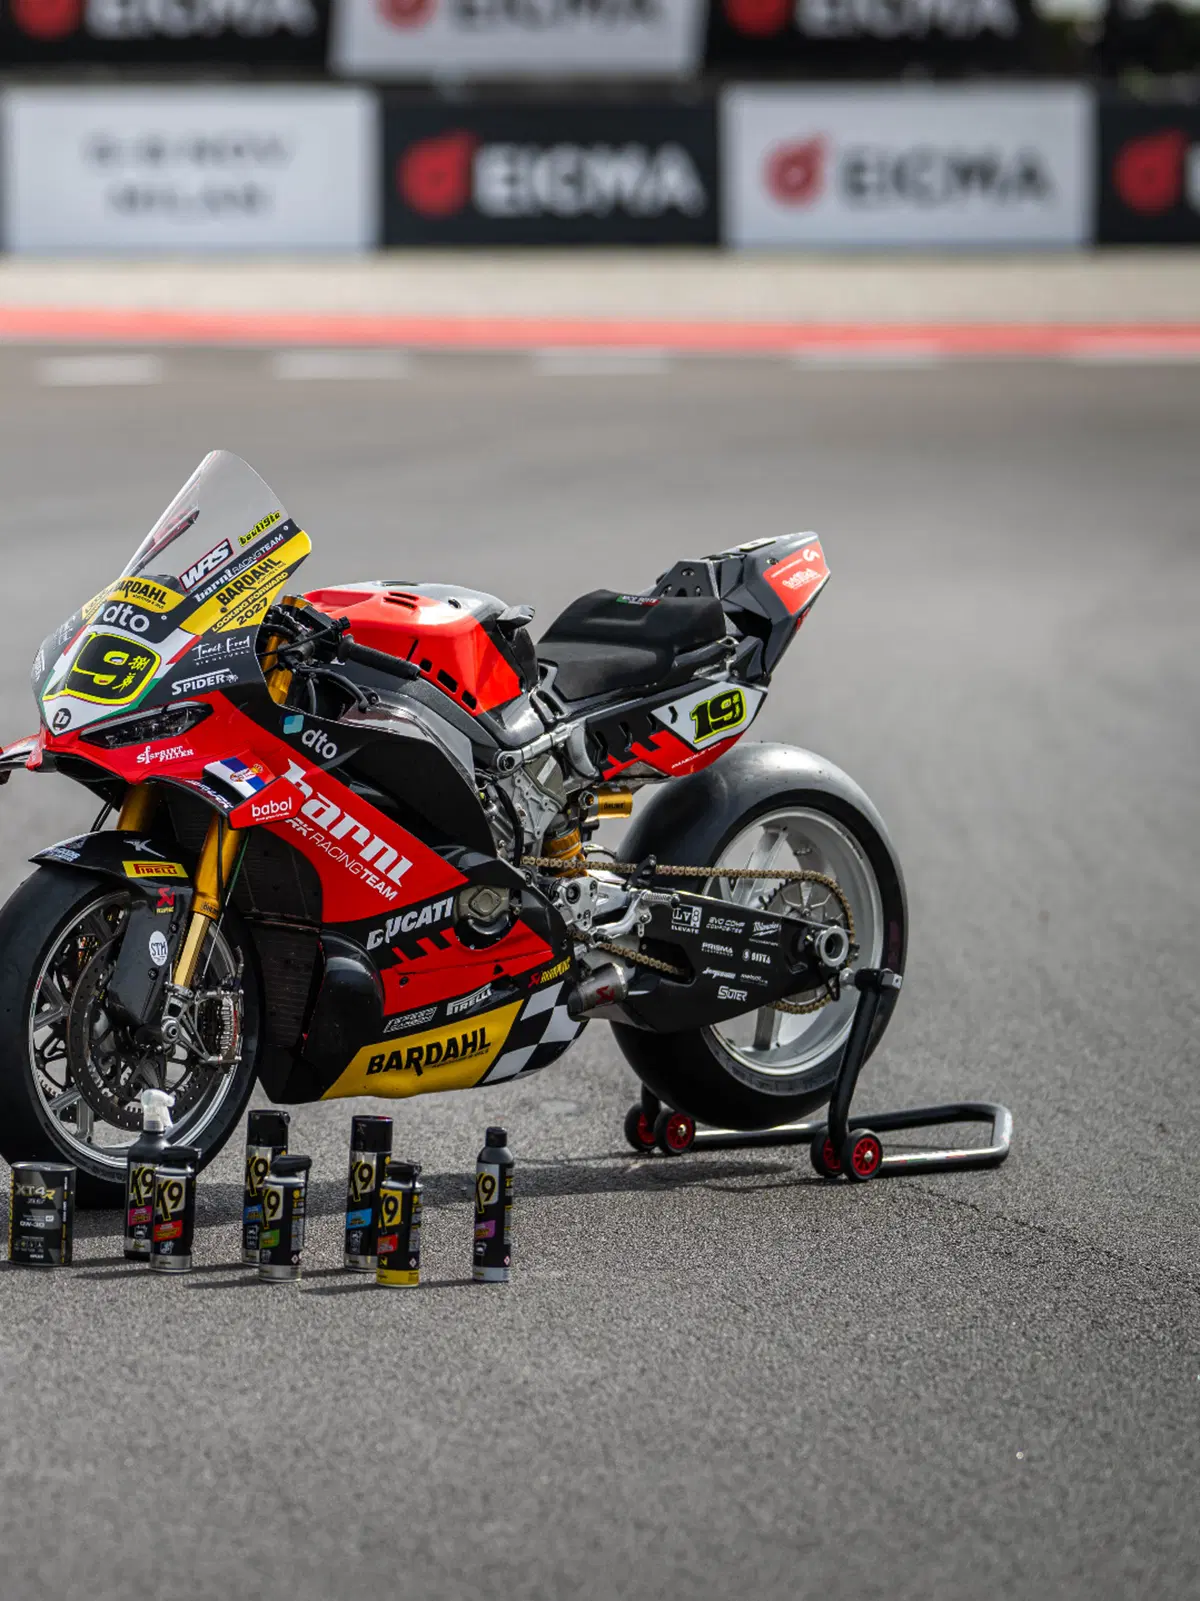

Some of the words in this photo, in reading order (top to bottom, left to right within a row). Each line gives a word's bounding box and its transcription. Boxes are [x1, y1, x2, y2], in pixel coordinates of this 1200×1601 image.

[475, 146, 706, 214] EICMA
[838, 148, 1054, 208] EICMA
[179, 541, 232, 590] WRS
[216, 558, 283, 606] BARDAHL
[103, 603, 150, 633] dto
[211, 599, 250, 632] LOOKING
[236, 597, 268, 626] 2027
[171, 668, 230, 696] SPIDER
[690, 687, 747, 744] 19
[301, 728, 338, 760] dto
[251, 797, 293, 818] babol
[133, 863, 178, 875] PIRELLI
[366, 896, 453, 950] DUCATI
[671, 924, 700, 935] ELEVATE
[151, 942, 167, 957] STM
[702, 942, 733, 955] PRISMA
[446, 982, 492, 1016] PIRELLI
[717, 985, 748, 1002] SUTER
[366, 1026, 492, 1077] BARDAHL
[129, 1166, 154, 1207] K9
[156, 1179, 184, 1222] K9
